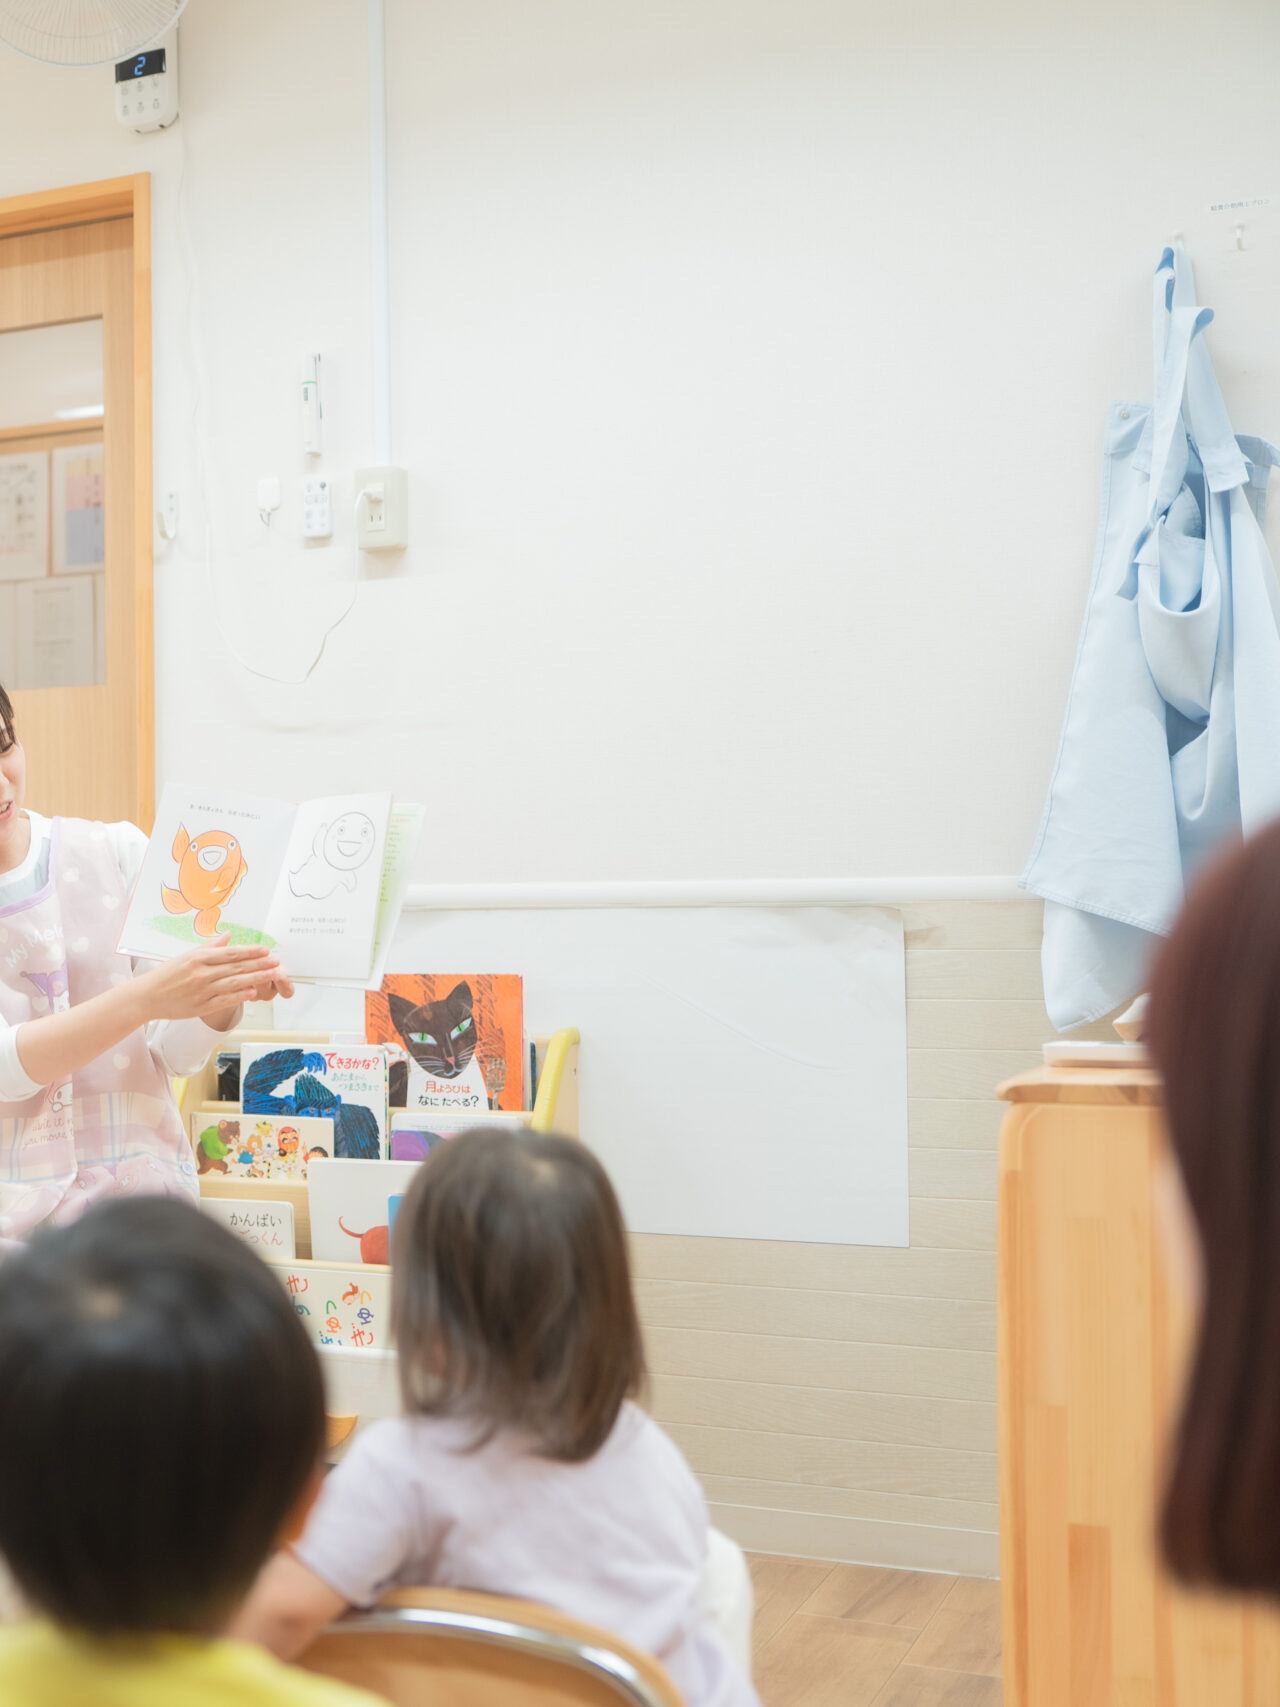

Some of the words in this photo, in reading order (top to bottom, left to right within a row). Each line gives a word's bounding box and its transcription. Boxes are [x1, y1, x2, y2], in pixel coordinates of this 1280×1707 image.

[134, 56, 146, 76] 2
[4, 943, 28, 968] My
[325, 1053, 380, 1070] できるかな?
